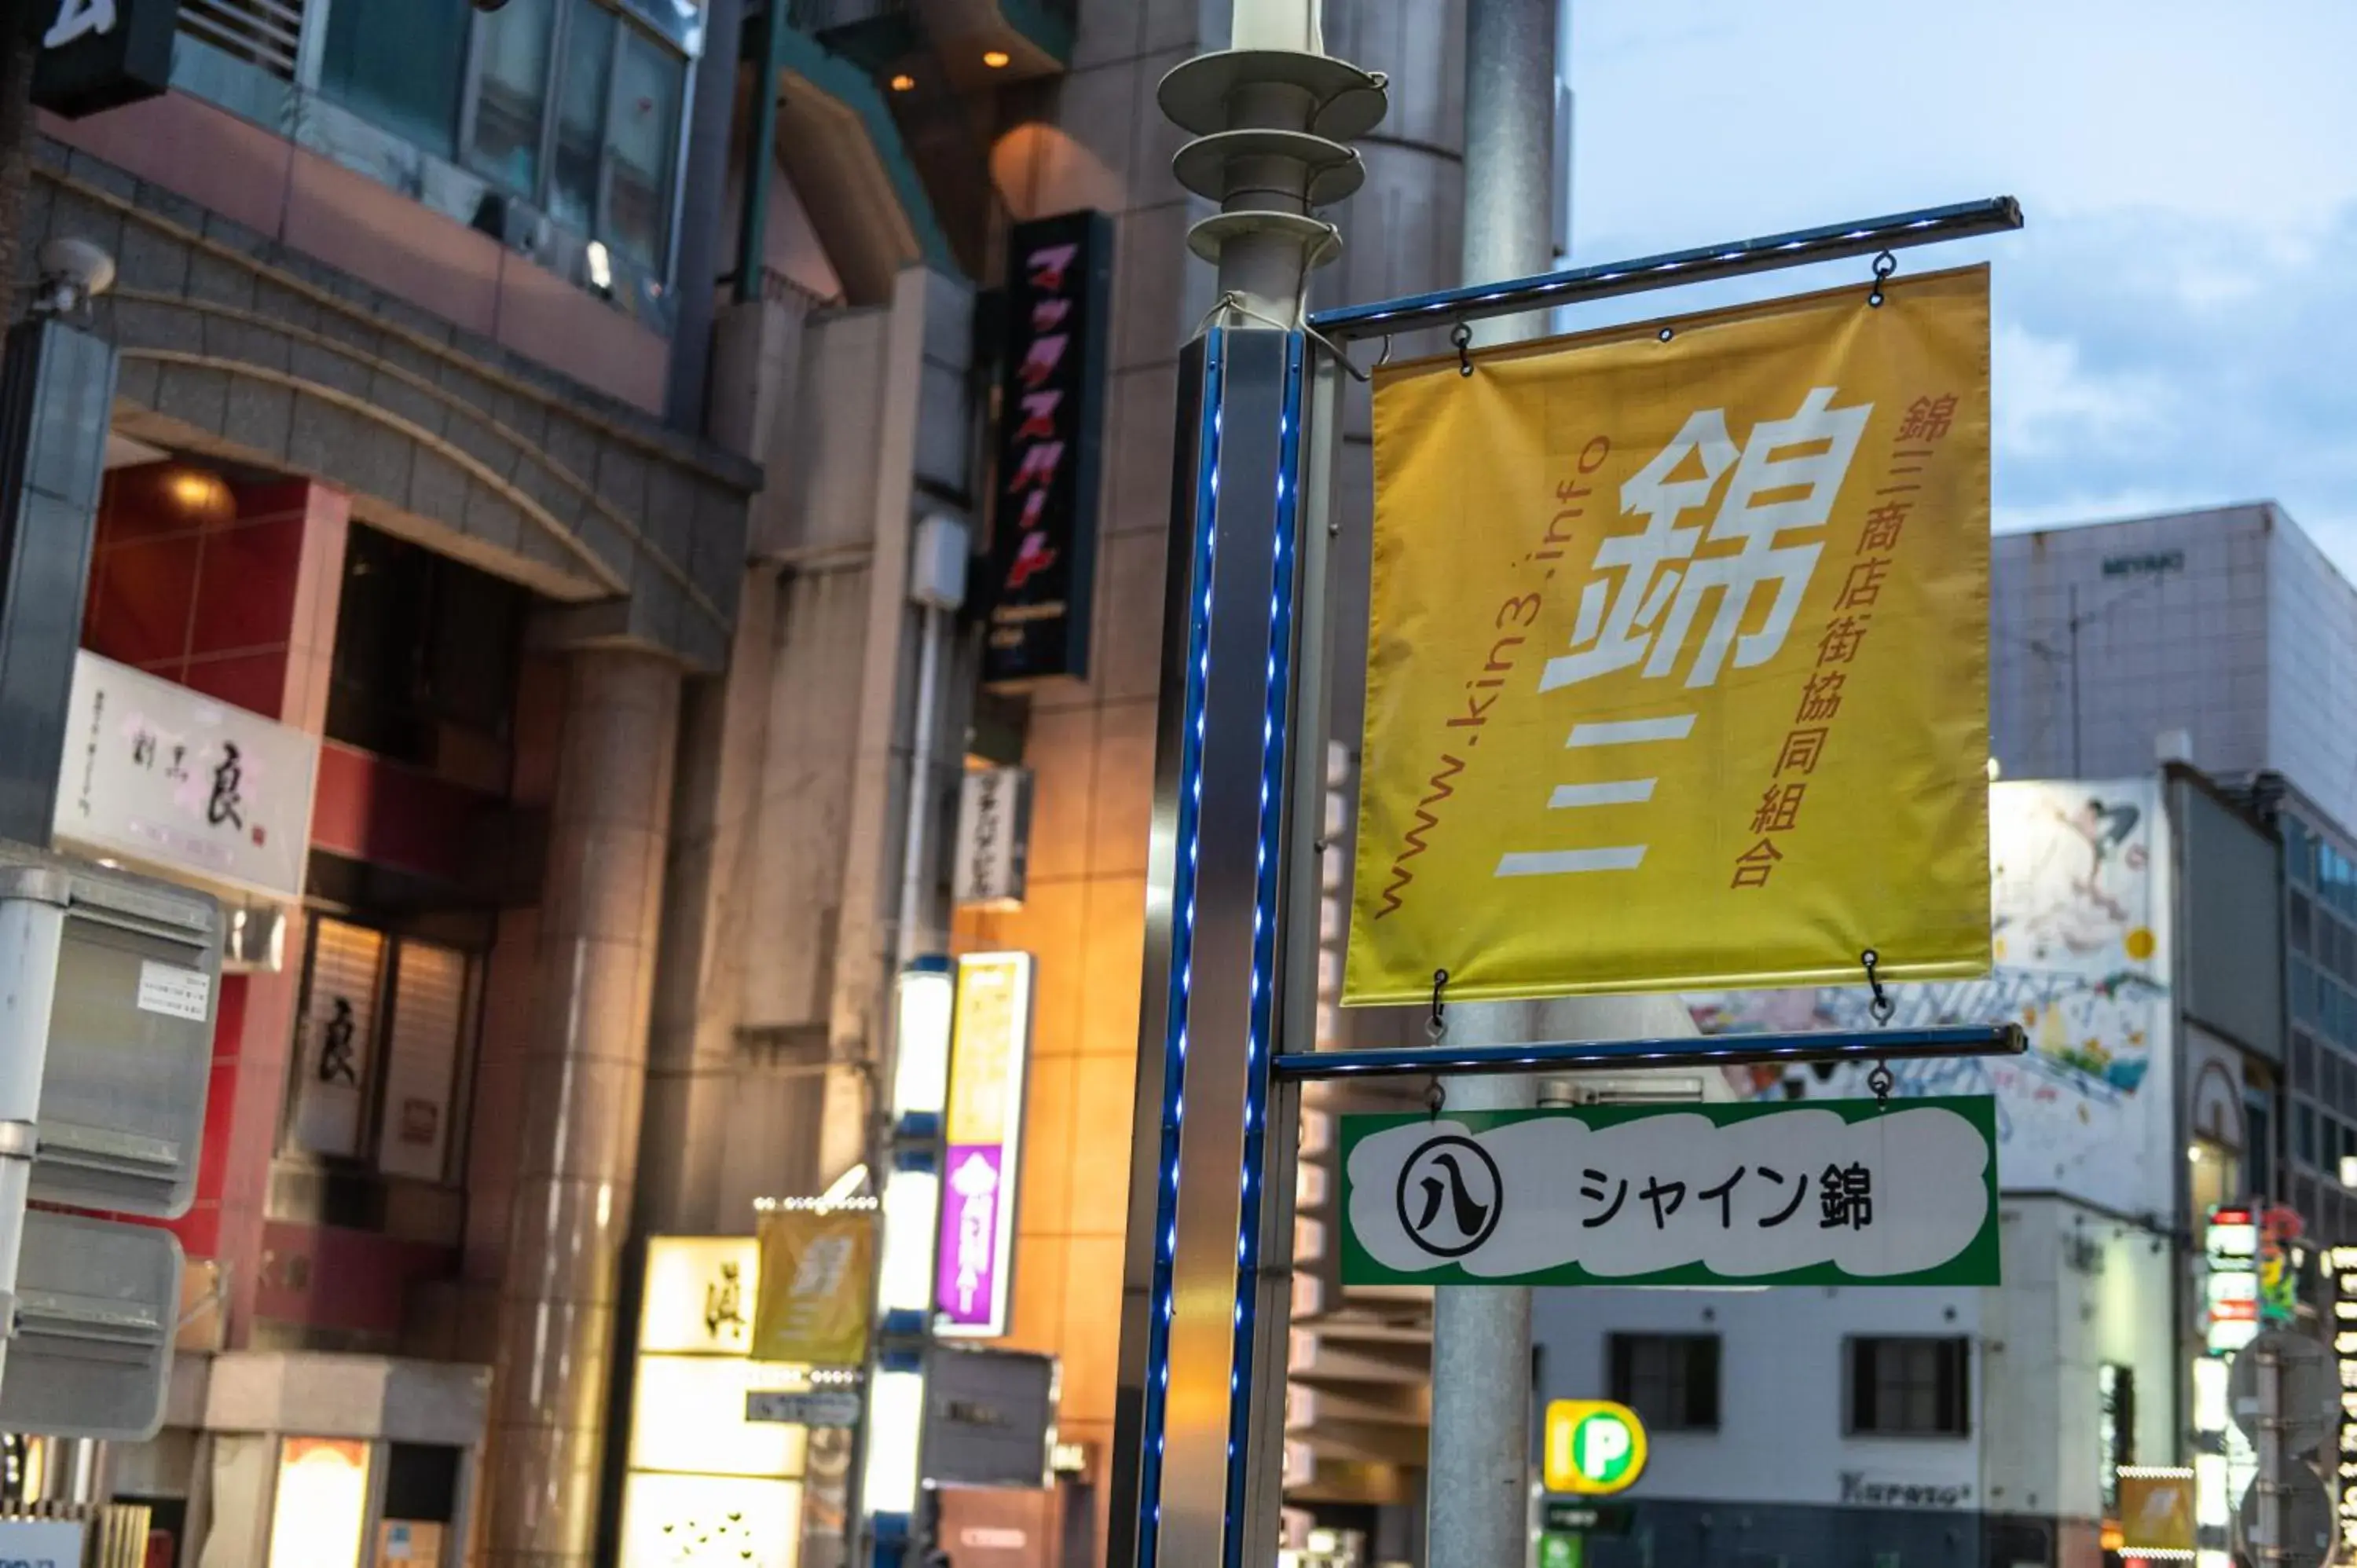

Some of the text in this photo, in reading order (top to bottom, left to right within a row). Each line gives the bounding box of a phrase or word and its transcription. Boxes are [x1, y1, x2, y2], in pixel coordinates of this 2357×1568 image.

[1373, 434, 1611, 921] www.kin3.info
[1494, 386, 1875, 877] 錦三
[1731, 392, 1959, 890] 錦三商店街協同組合
[1412, 1149, 1874, 1241] 八 シャイン錦
[1583, 1418, 1630, 1478] P
